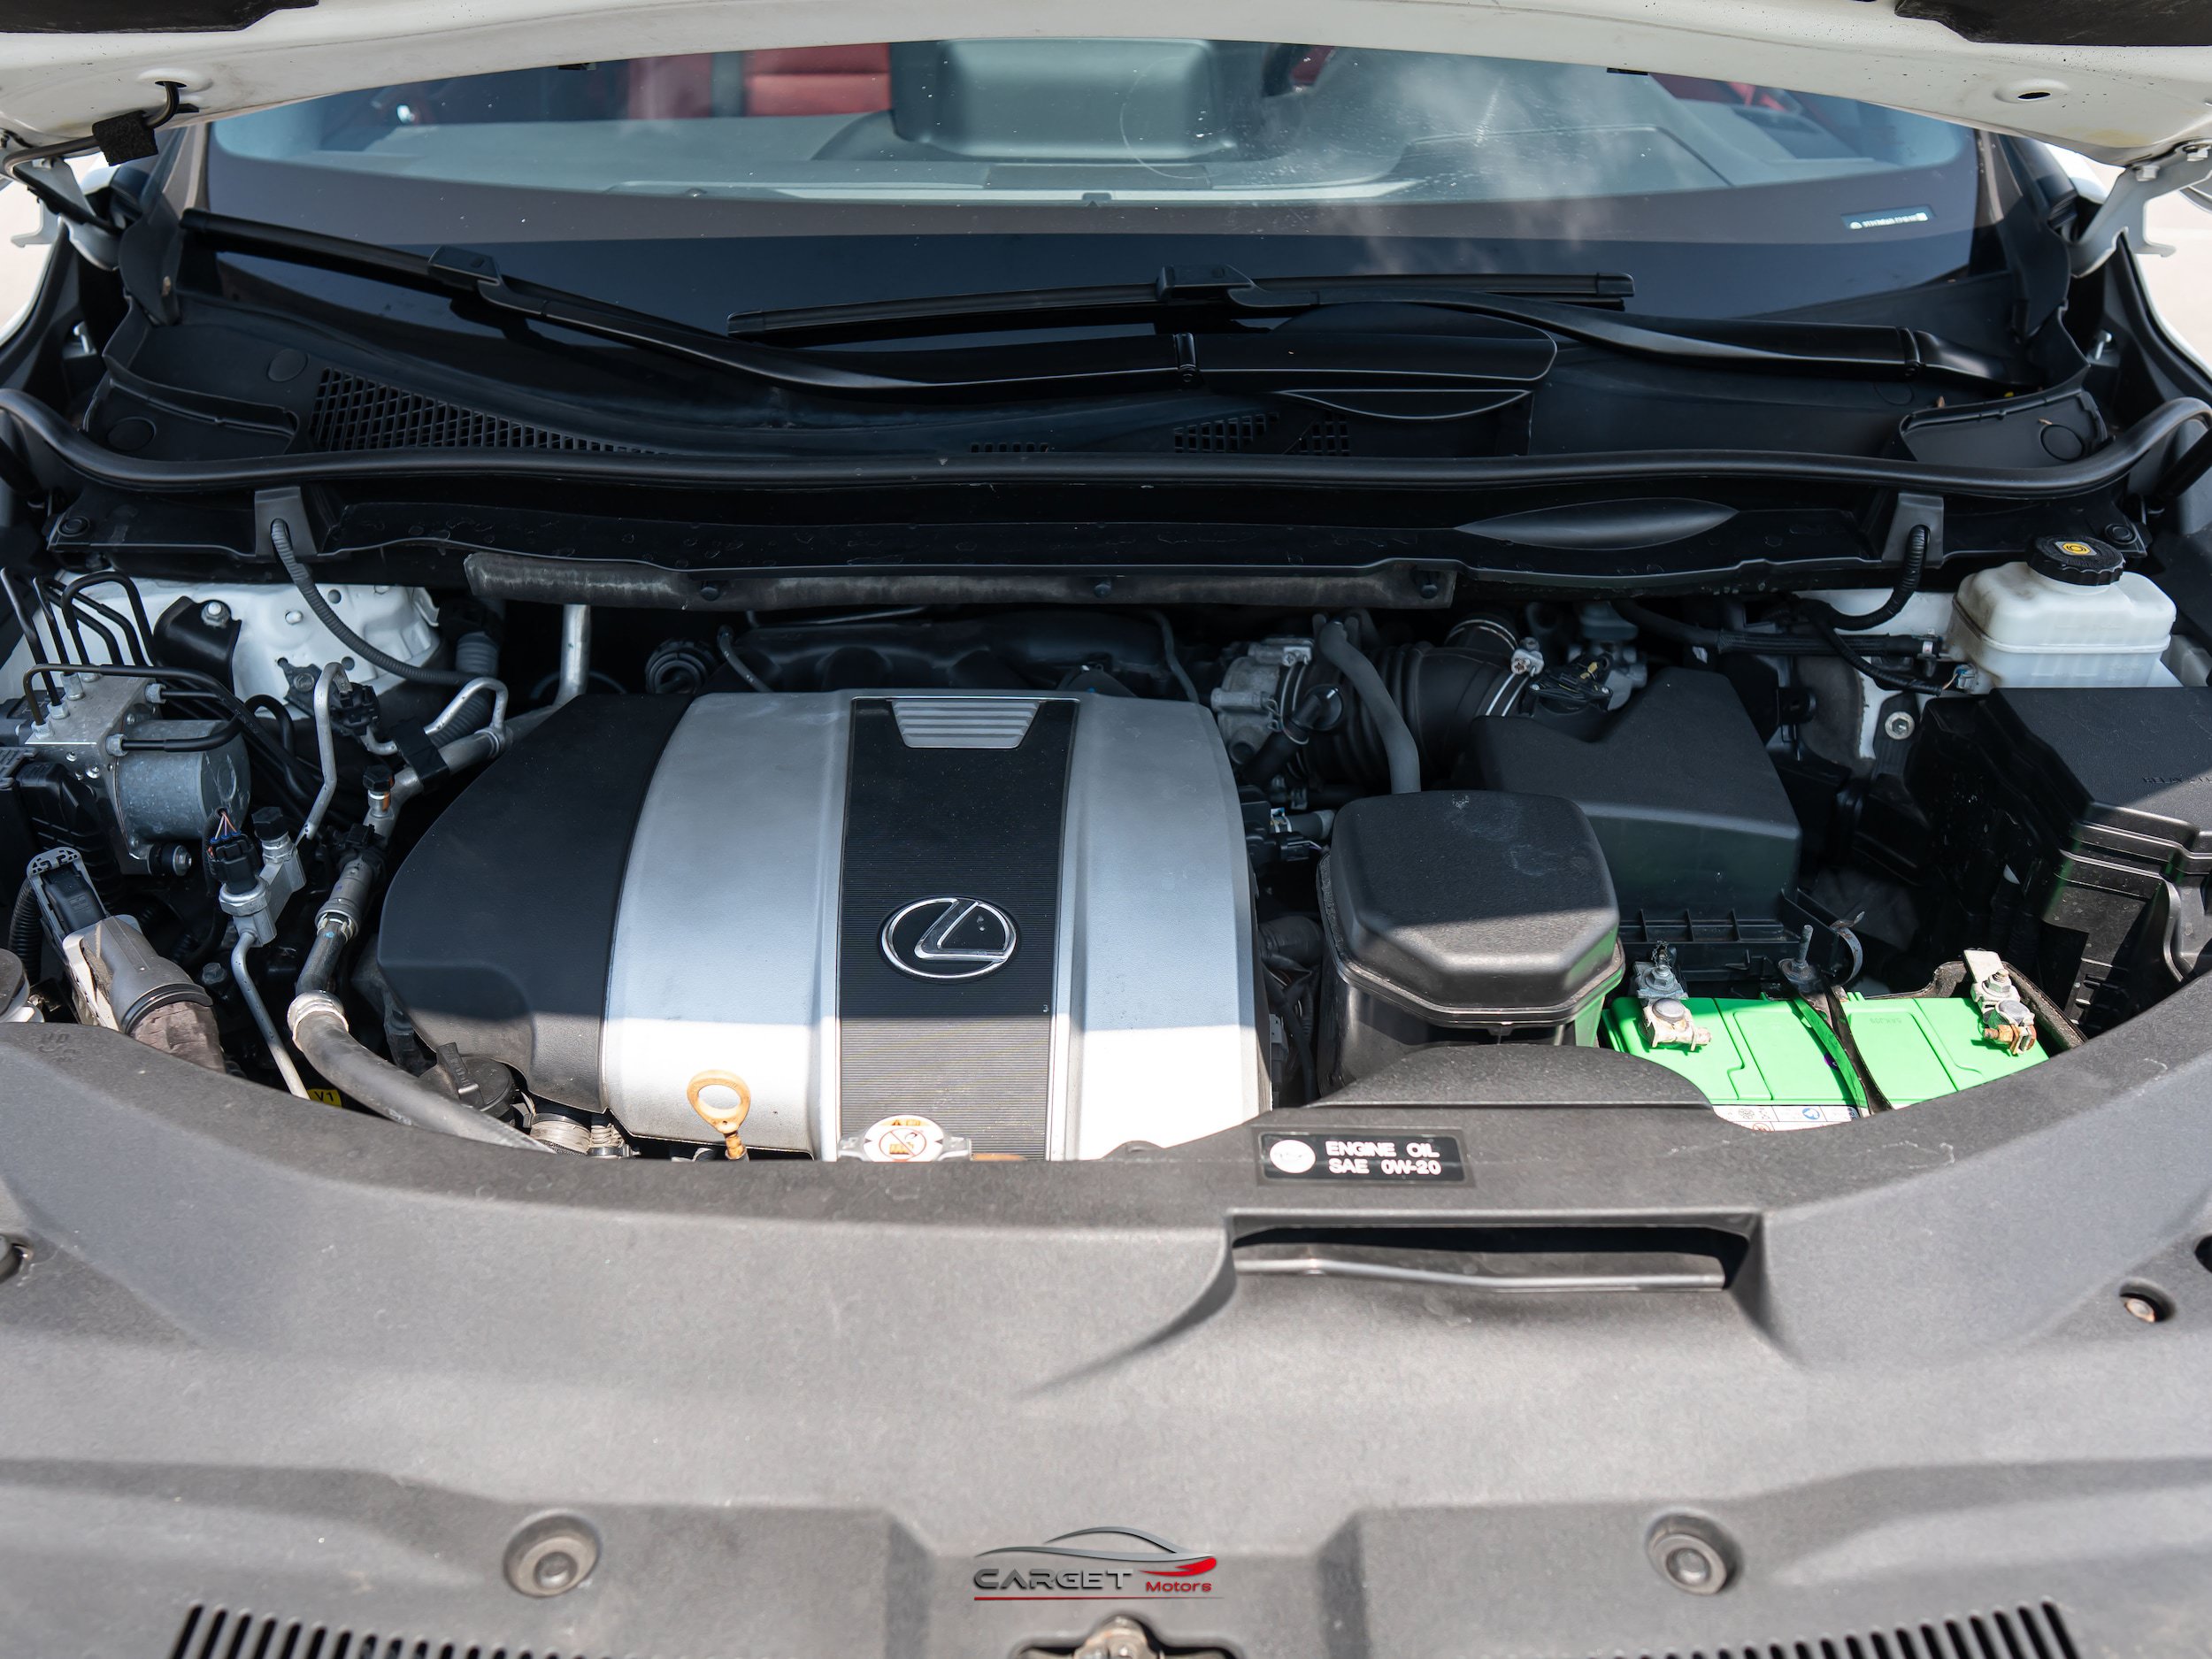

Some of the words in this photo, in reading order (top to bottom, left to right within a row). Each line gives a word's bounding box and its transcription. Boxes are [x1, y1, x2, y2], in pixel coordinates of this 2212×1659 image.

[1325, 1141, 1397, 1157] ENGINE
[1406, 1142, 1440, 1158] OIL
[1328, 1157, 1370, 1174] SAE
[1380, 1159, 1442, 1175] 0W-20
